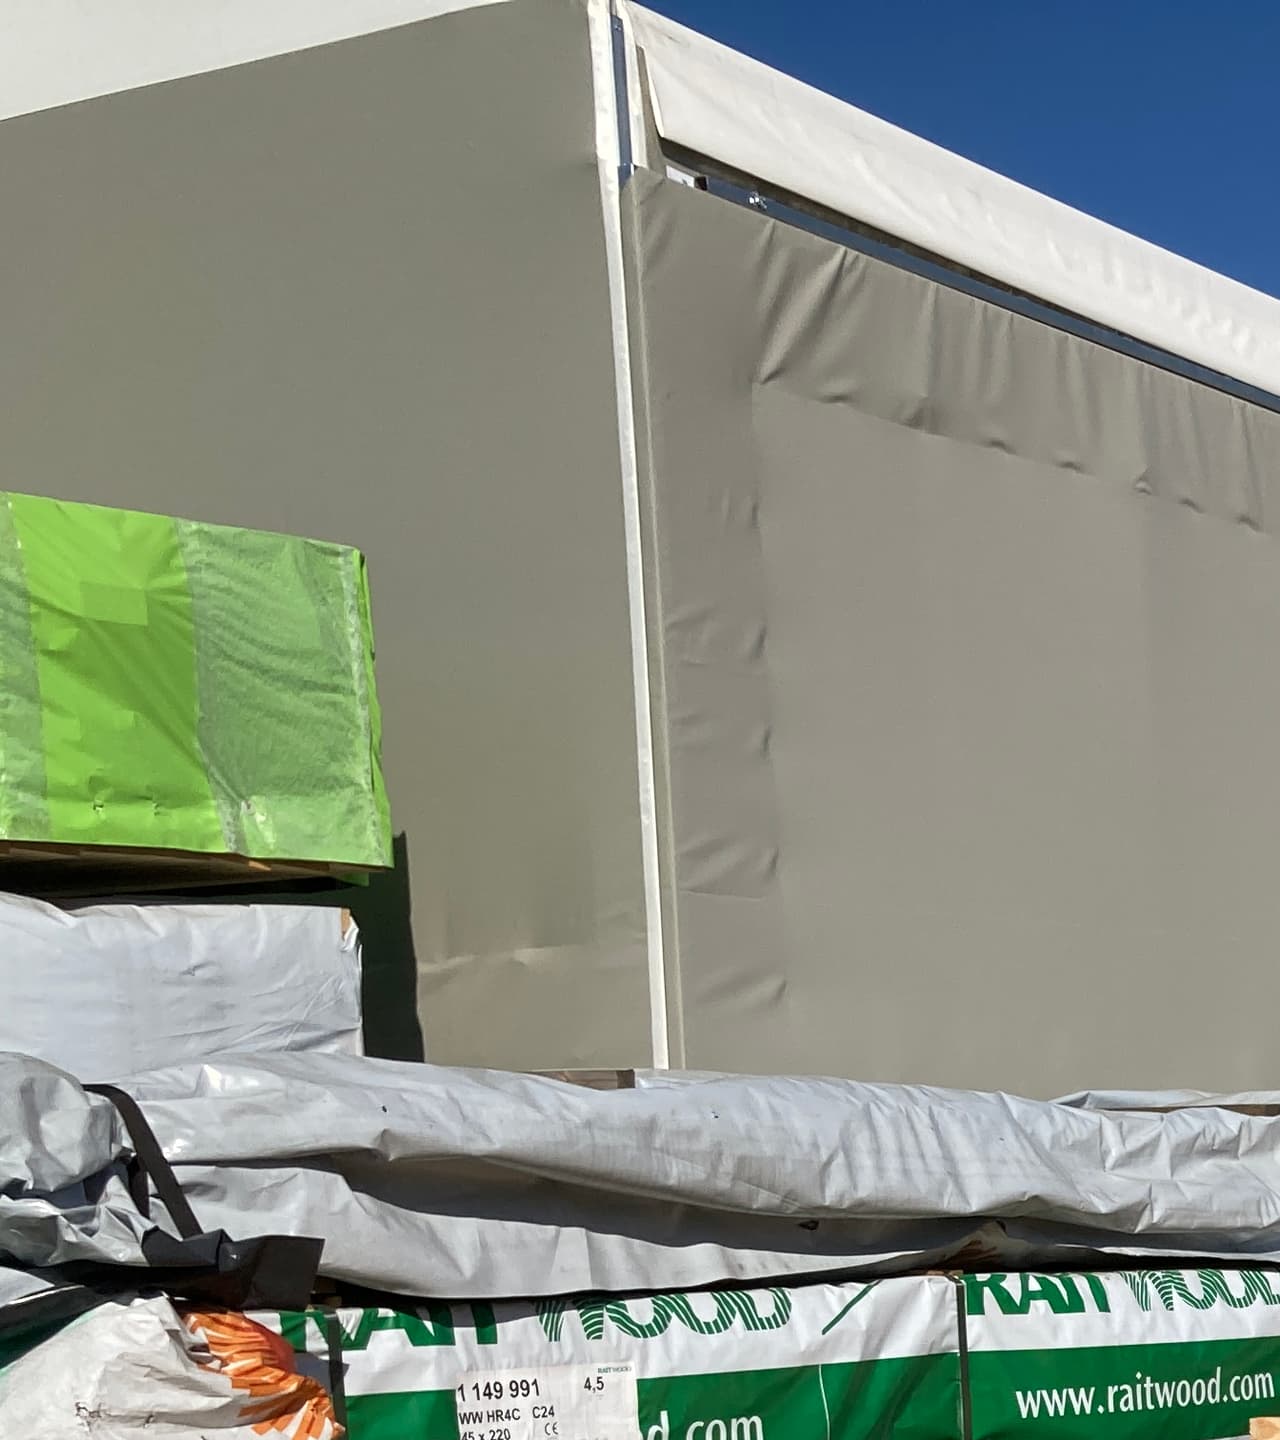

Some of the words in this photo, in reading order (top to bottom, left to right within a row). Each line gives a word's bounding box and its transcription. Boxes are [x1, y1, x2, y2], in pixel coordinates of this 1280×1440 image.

[457, 1384, 466, 1402] 1
[472, 1381, 503, 1401] 149
[509, 1378, 540, 1398] 991
[583, 1377, 605, 1393] 4,5
[1016, 1366, 1275, 1419] www.raitwood.com
[459, 1411, 483, 1425] WW
[487, 1408, 521, 1423] HR4C
[532, 1405, 555, 1419] C24
